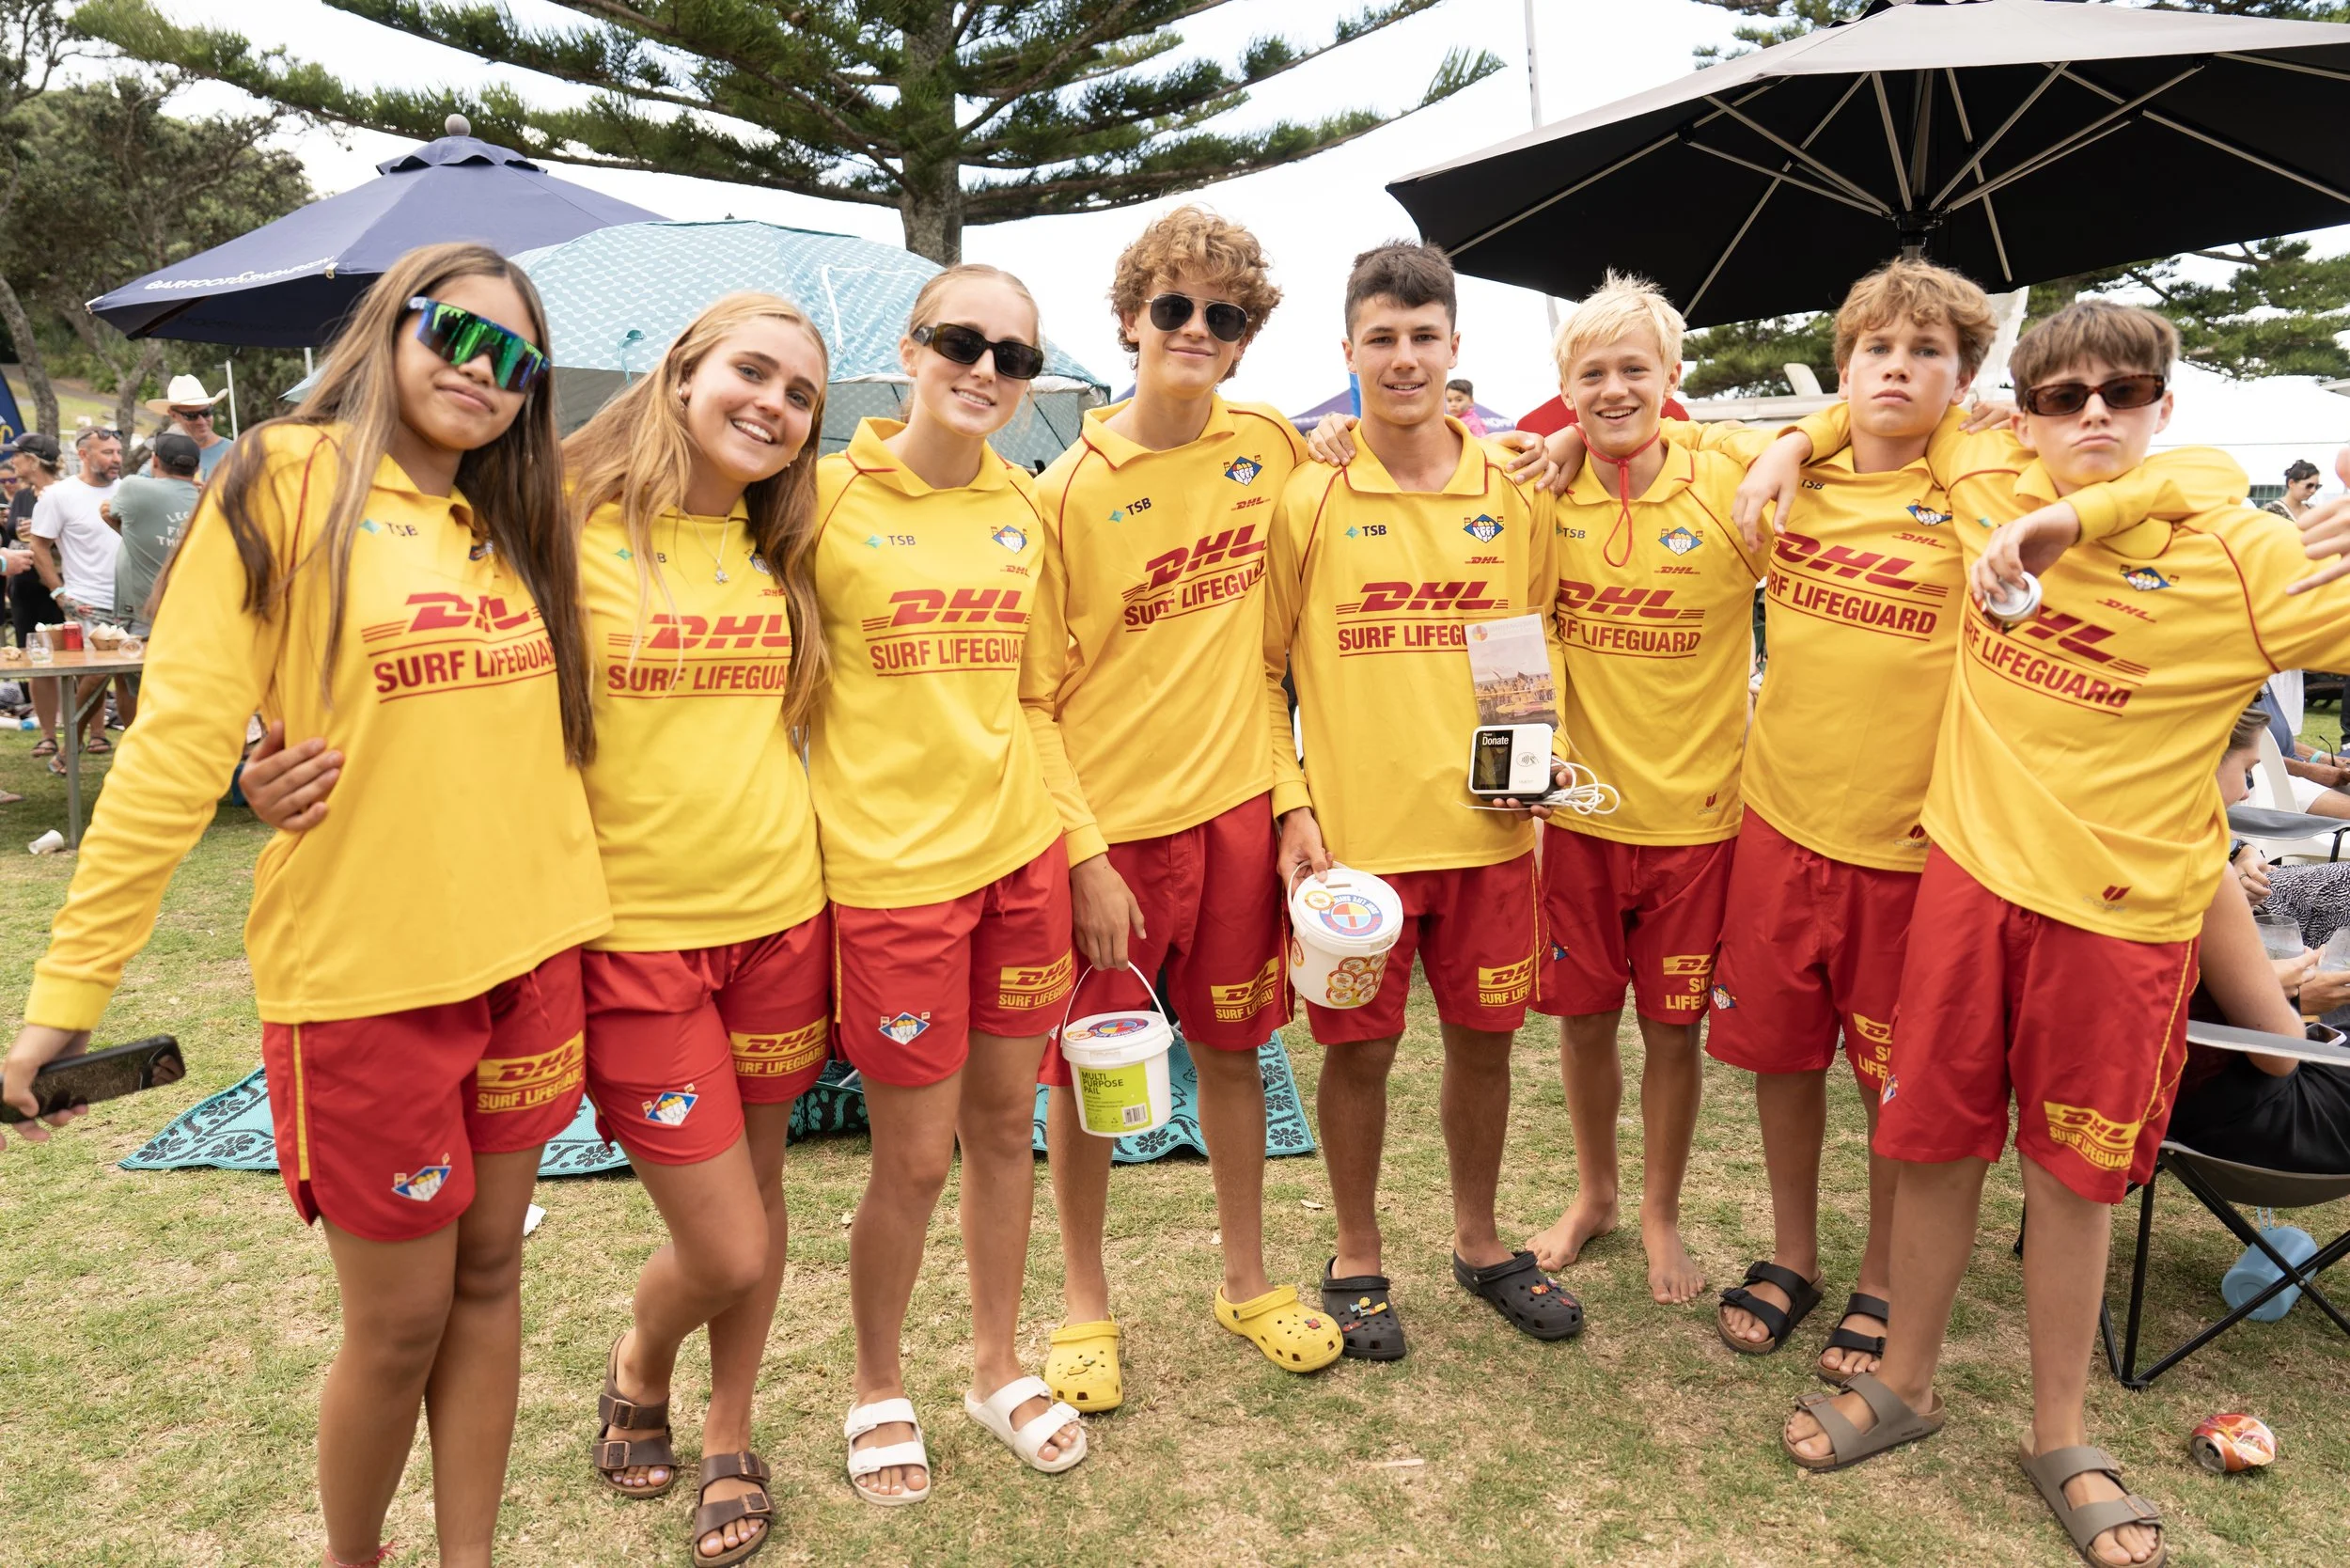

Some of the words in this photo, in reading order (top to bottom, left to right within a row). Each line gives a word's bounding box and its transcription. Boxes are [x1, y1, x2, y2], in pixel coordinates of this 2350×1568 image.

[1126, 497, 1152, 516] TSB
[1235, 496, 1265, 510] DHL
[384, 521, 419, 537] TSB
[1362, 525, 1387, 537] TSB
[1562, 527, 1587, 539] TSB
[1900, 532, 1941, 547] DHL
[887, 534, 916, 546] TSB
[1144, 524, 1266, 591] DHL
[1775, 532, 1919, 590] DHL
[1006, 564, 1031, 577] DHL
[1661, 566, 1694, 574] DHL
[1359, 581, 1496, 612] DHL
[1556, 578, 1682, 619] DHL
[888, 588, 1029, 628] DHL
[1793, 581, 1937, 635] LIFEGUARD
[2104, 598, 2150, 619] DHL
[647, 614, 792, 650] DHL
[1338, 625, 1396, 651] SURF
[1558, 617, 1578, 638] RF
[1581, 623, 1701, 652] LIFEGUARD
[2025, 604, 2117, 664] HL
[870, 640, 931, 670] SURF
[373, 650, 464, 694] SURF
[607, 665, 687, 692] SURF
[1982, 635, 2133, 708] LIFEGUARD
[1481, 736, 1510, 745] Donate
[1016, 958, 1068, 985] DHL
[998, 994, 1032, 1007] SURF
[1480, 992, 1509, 1004] SURF
[1214, 1009, 1245, 1019] SURF
[745, 1027, 817, 1053] DHL
[498, 1044, 574, 1082] DHL
[736, 1060, 763, 1074] URF
[1081, 1071, 1107, 1081] MULTI
[1083, 1078, 1124, 1088] PURPOSE
[477, 1091, 522, 1109] SURF
[1084, 1086, 1101, 1094] PAIL
[2049, 1125, 2083, 1147] SURF
[2061, 1108, 2128, 1144] DHL
